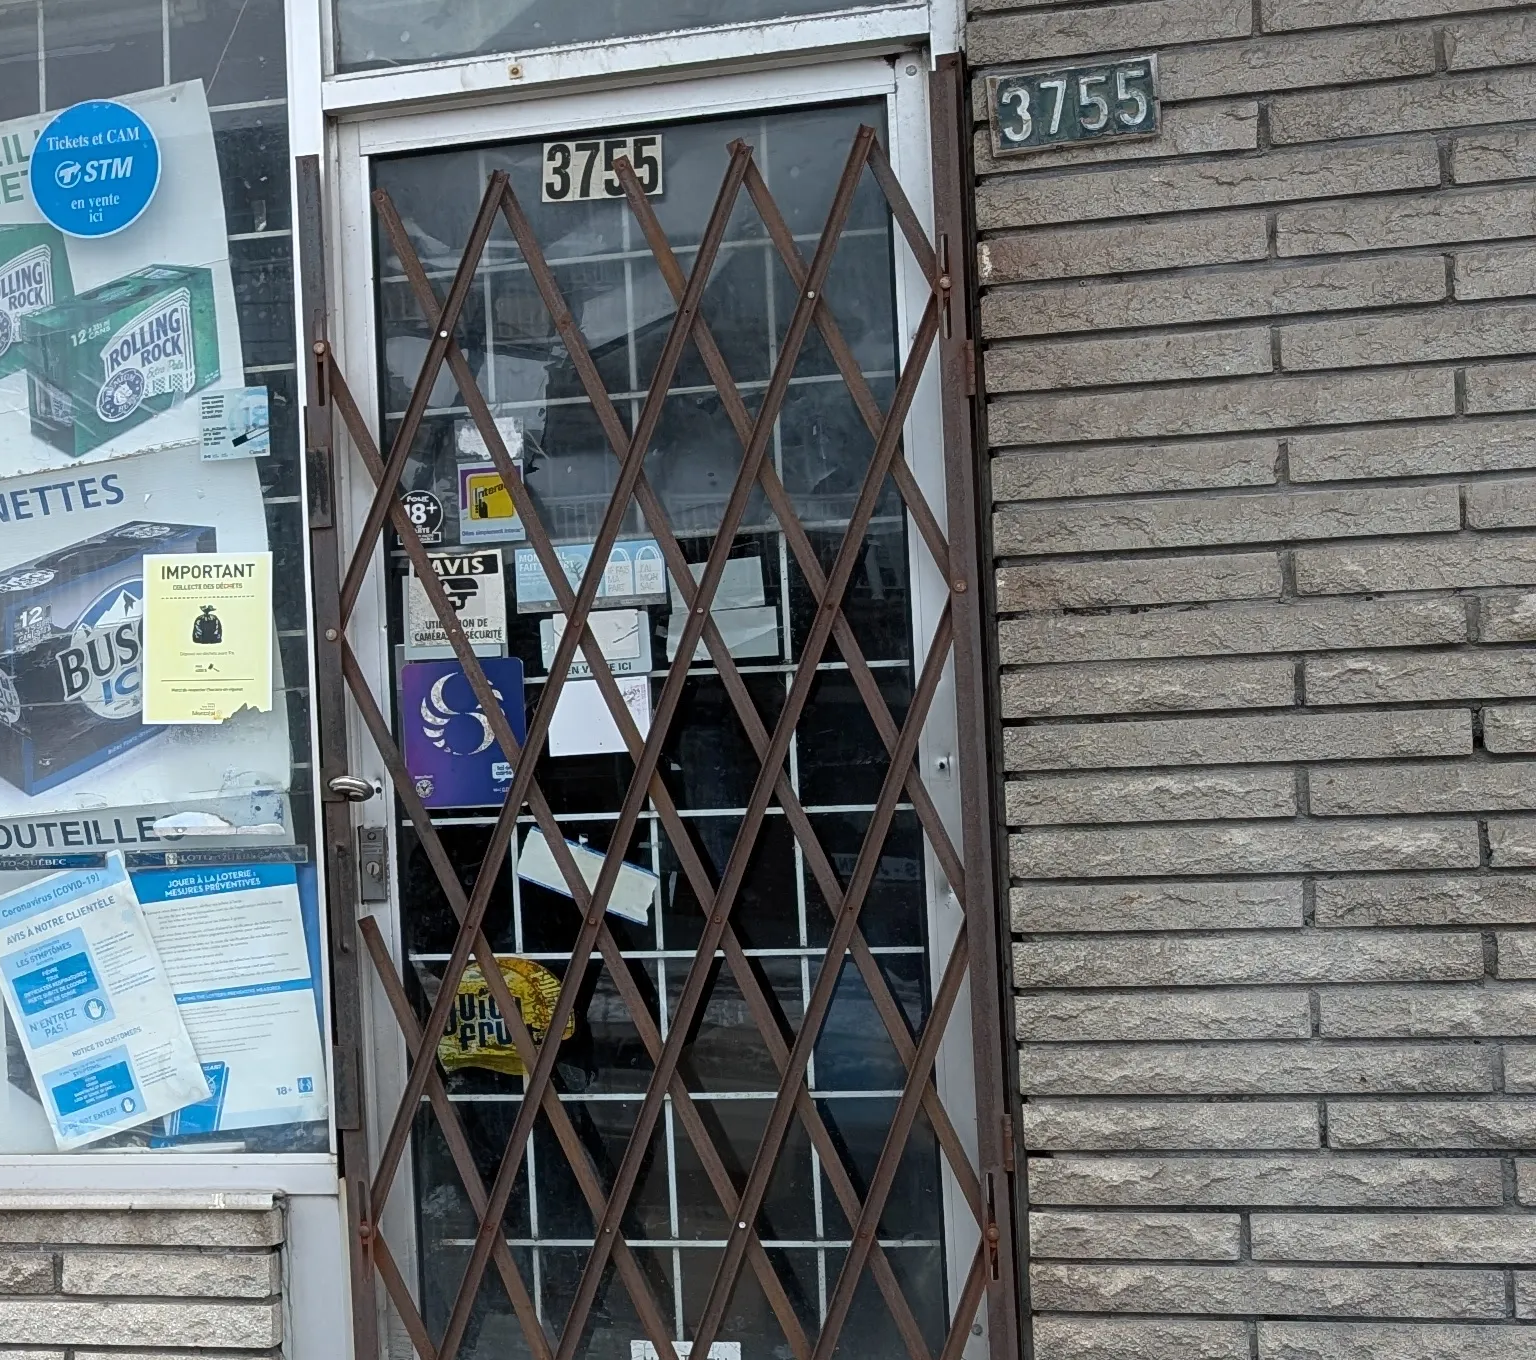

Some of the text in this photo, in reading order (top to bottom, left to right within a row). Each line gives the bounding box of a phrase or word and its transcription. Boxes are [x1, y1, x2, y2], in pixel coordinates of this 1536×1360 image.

[1002, 69, 1147, 142] 3755
[46, 126, 140, 152] Tickets et CAM
[83, 156, 134, 183] STM
[545, 136, 659, 200] 3755
[70, 193, 120, 210] en vente
[89, 208, 104, 223] ici
[8, 285, 45, 311] ROCK
[70, 328, 88, 347] 12
[109, 307, 181, 372] ROLLING
[141, 333, 184, 368] ROCK
[161, 563, 256, 580] IMPORTANT
[431, 557, 485, 575] AVIS
[19, 605, 44, 628] 12
[477, 618, 488, 628] DE
[414, 627, 503, 642] CAMÉRA SÉCURITÉ
[59, 619, 144, 699] BUS
[618, 661, 632, 671] ICI
[101, 665, 140, 706] IC
[165, 877, 261, 898] MESURES PRÉVENTIVES
[167, 877, 196, 889] JOUER
[197, 873, 203, 884] À
[204, 874, 215, 883] LA
[216, 869, 252, 882] LOTERIE
[1, 872, 100, 919] Coronavirus (COVID-19)
[6, 895, 116, 946] AVIS À NOTRE CLIENTÈLE
[16, 957, 30, 969] LES
[30, 940, 73, 963] SYMPTÔMES
[28, 1007, 78, 1033] N'ENTREZ
[44, 1024, 65, 1038] PAS
[71, 1045, 95, 1058] NOTICE
[276, 1086, 293, 1096] 18+
